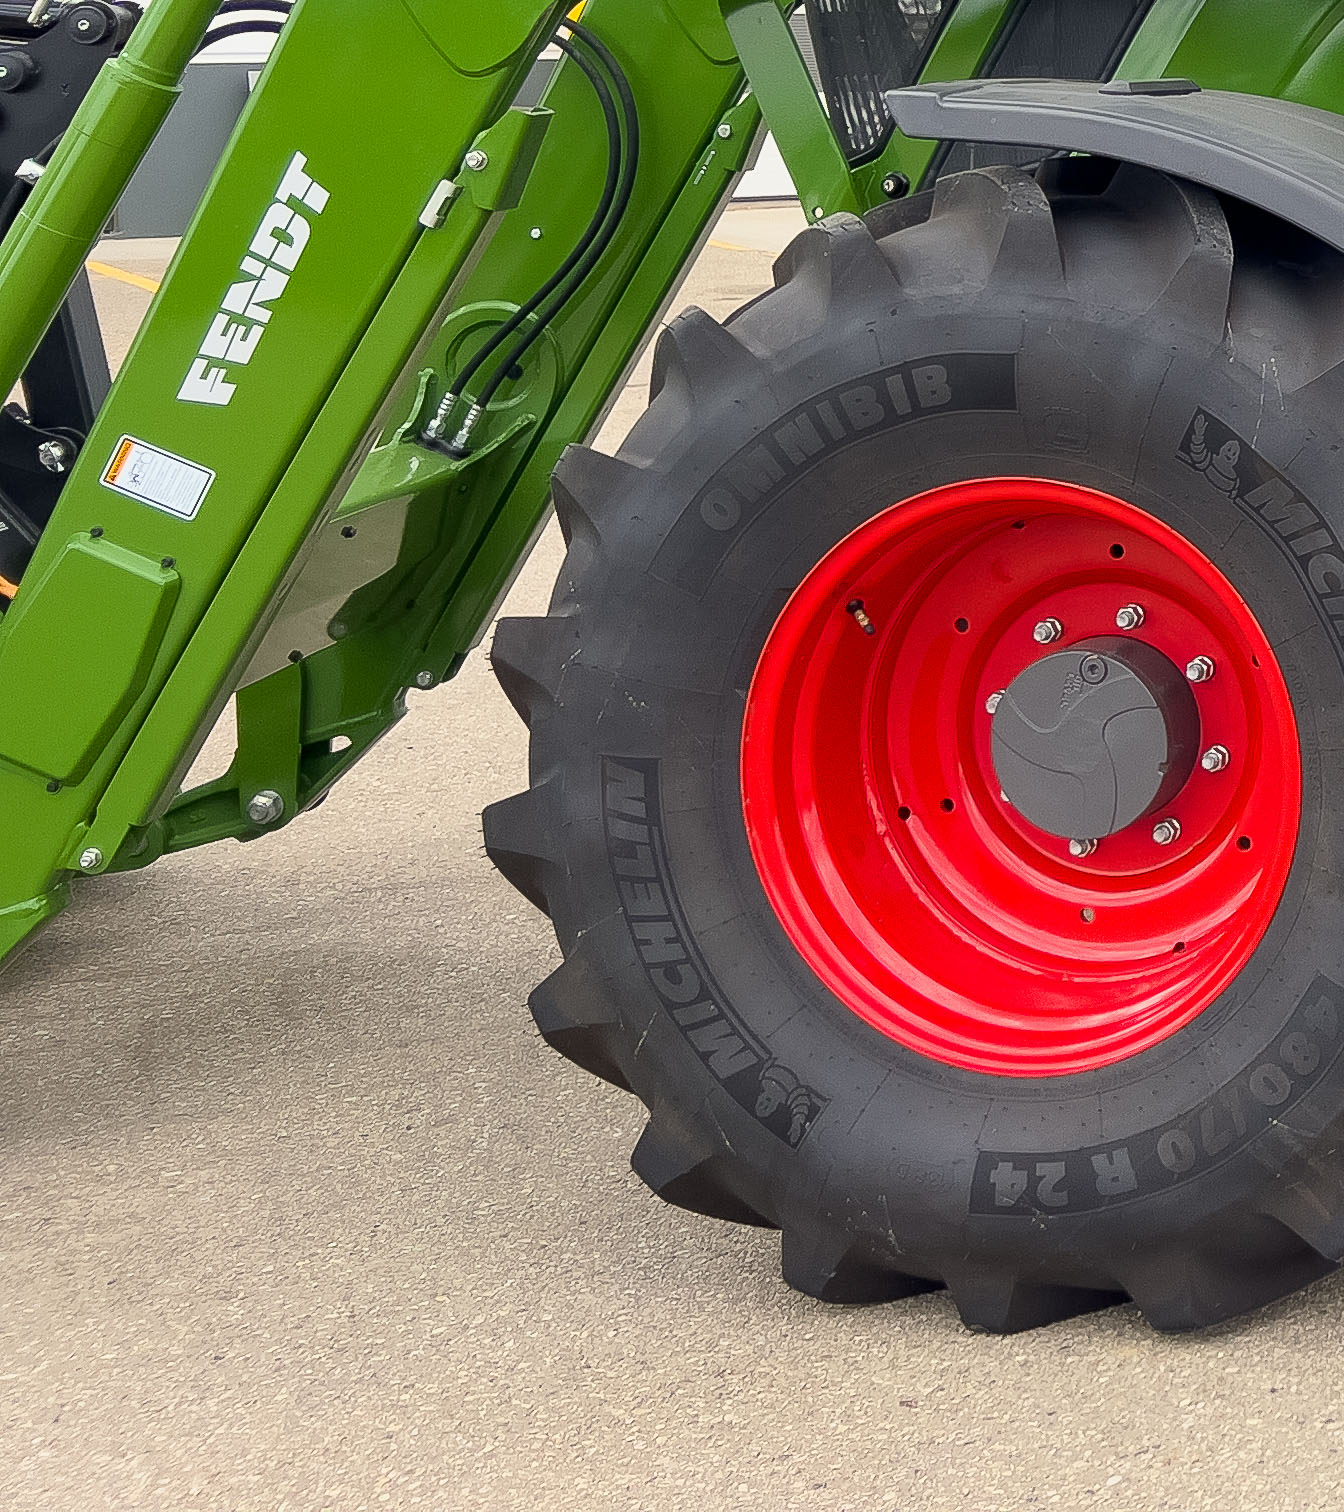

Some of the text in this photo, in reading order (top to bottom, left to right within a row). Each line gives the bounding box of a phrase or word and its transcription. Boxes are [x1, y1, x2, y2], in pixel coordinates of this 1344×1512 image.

[175, 150, 331, 406] FENDT
[698, 363, 952, 532] OMNIBIB
[604, 760, 760, 1081] MICHELIN
[989, 1160, 1070, 1208] 24
[1090, 1146, 1139, 1197] R
